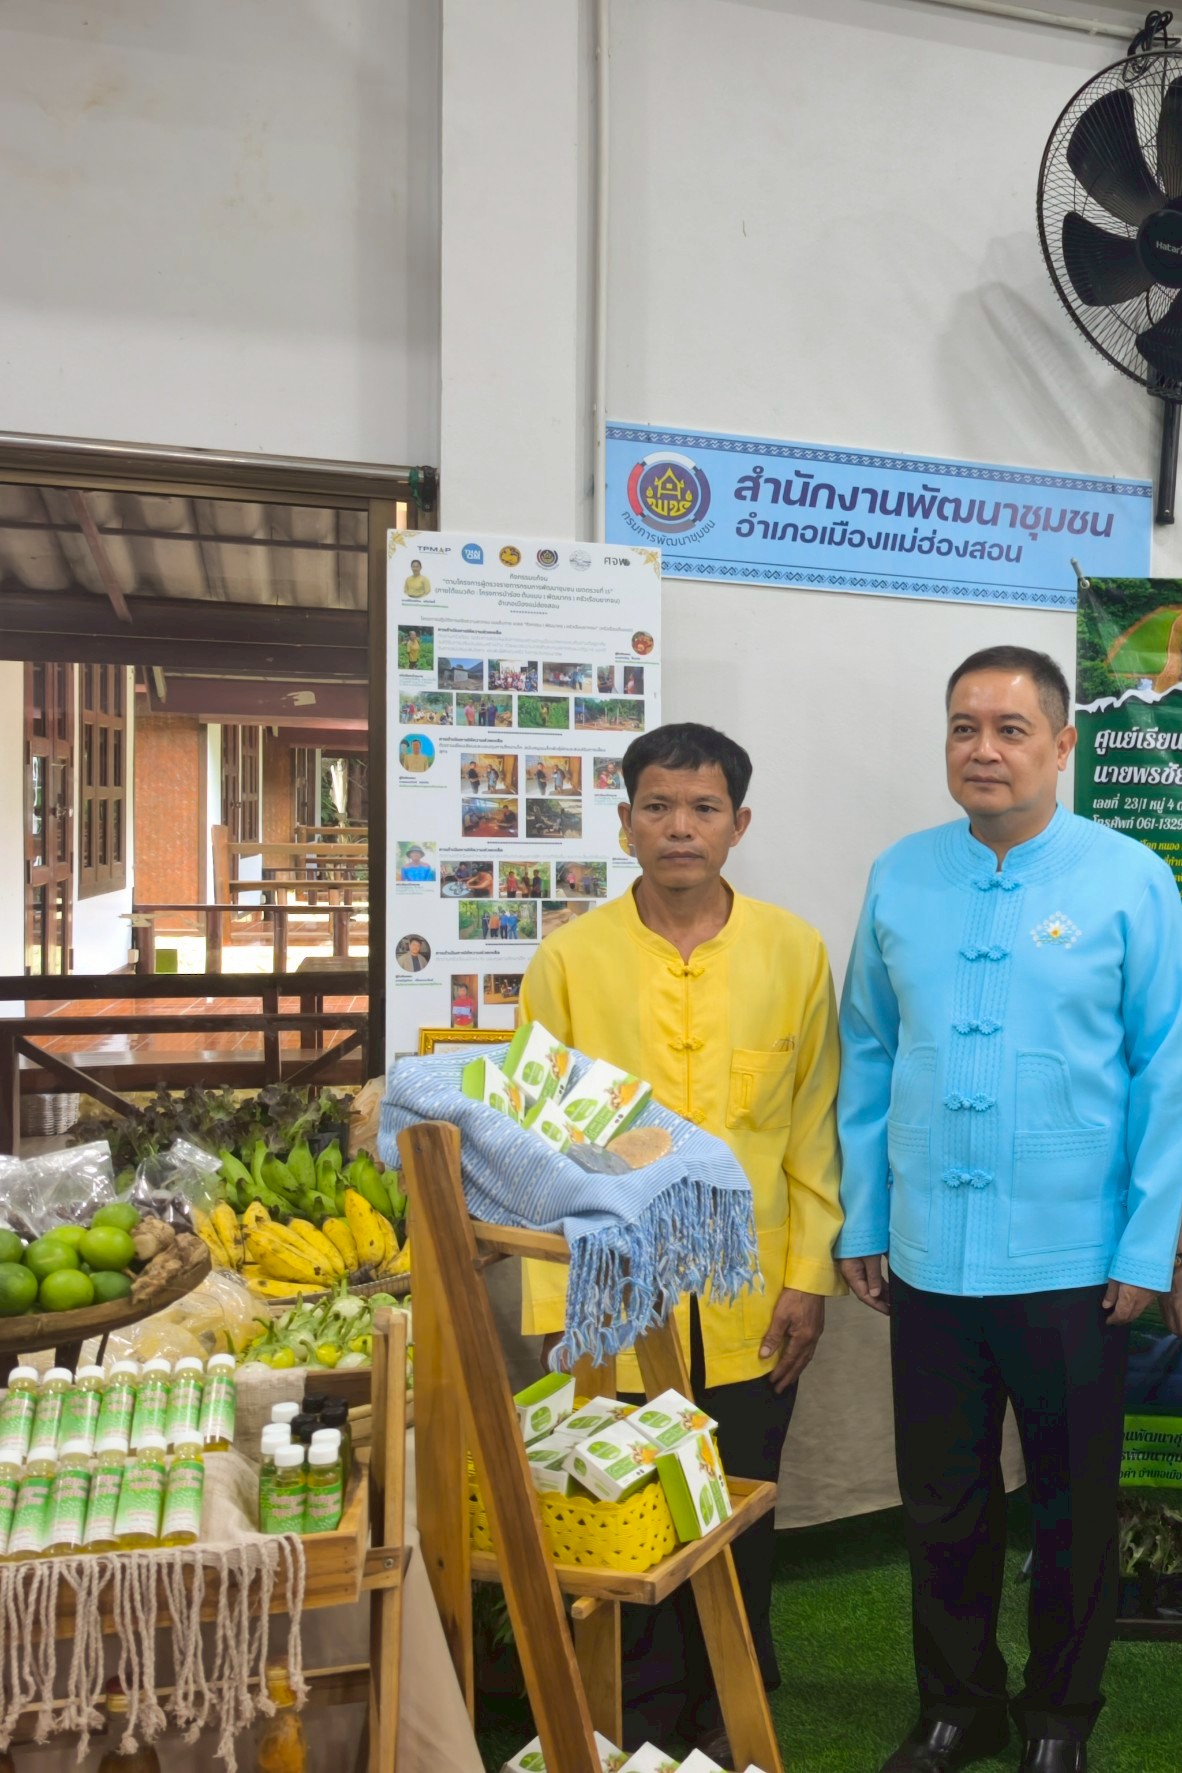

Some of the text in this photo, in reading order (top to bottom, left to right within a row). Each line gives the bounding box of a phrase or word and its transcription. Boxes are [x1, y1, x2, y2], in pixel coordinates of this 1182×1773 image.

[734, 465, 1115, 541] สำนักงานพัฒนาชุมชน
[620, 510, 717, 547] กรมการพัฒนาชุมชน
[735, 515, 1023, 565] อำเภอเมืองแม่ฮ่องสอน
[1092, 793, 1120, 809] เลขที่
[1124, 797, 1148, 813] 23/1
[1149, 797, 1166, 814] หมู่
[1167, 799, 1174, 811] 4
